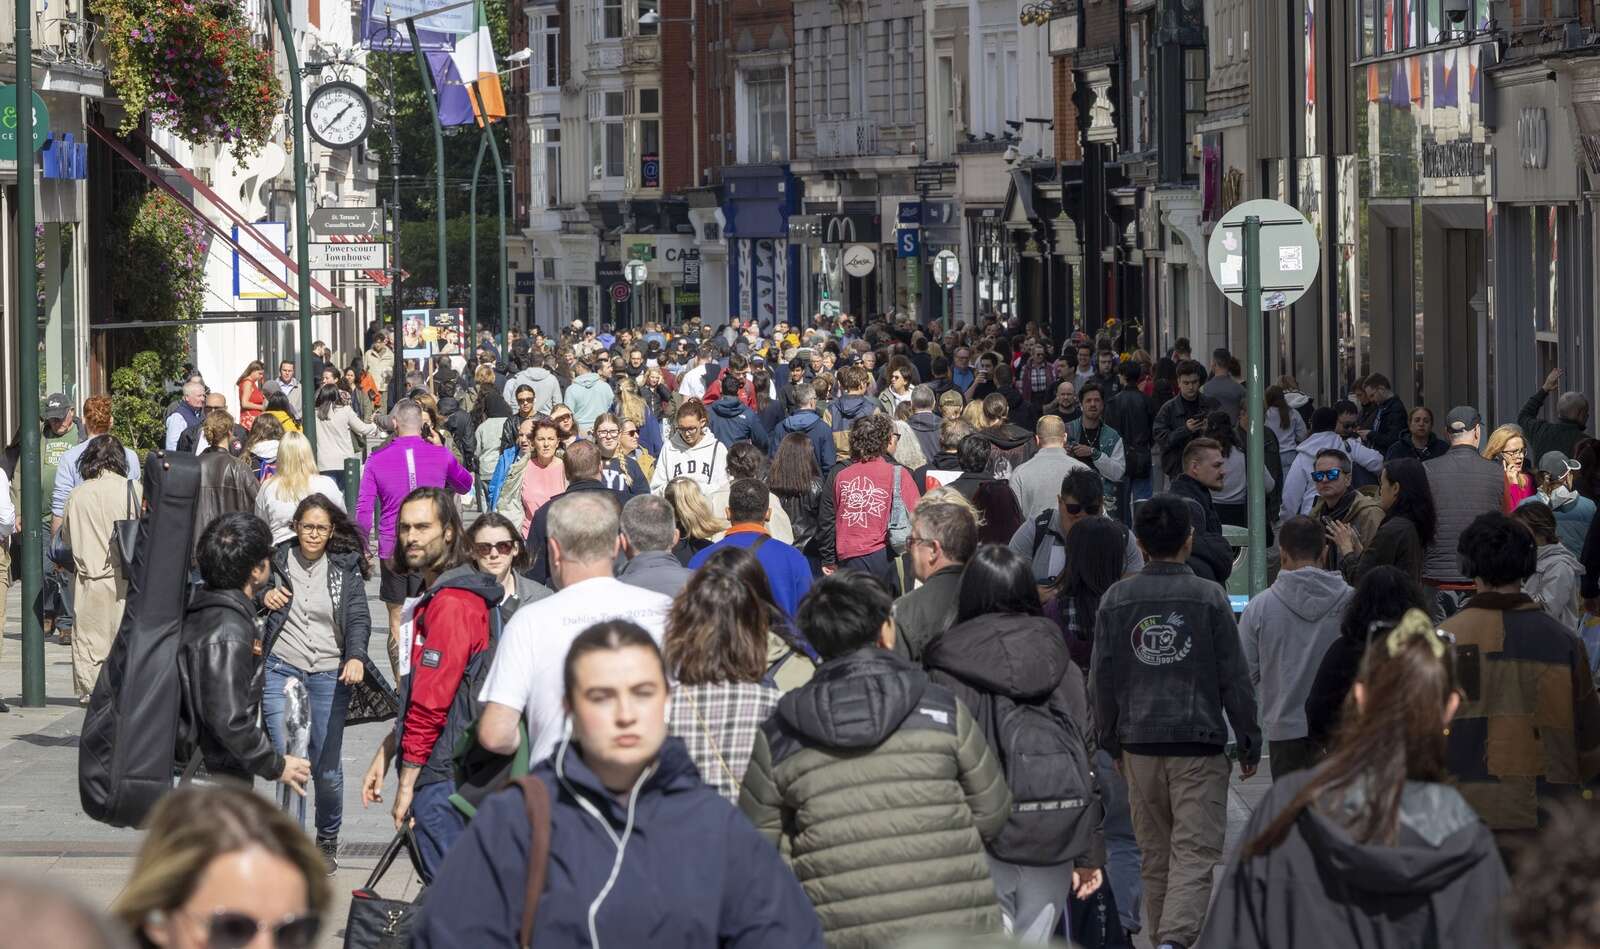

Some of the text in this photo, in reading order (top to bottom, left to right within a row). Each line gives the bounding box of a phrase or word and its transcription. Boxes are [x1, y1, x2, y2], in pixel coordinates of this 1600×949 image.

[335, 89, 344, 98] 12
[903, 233, 915, 252] S
[324, 244, 377, 253] Powerscourt
[325, 253, 372, 262] Townhouse
